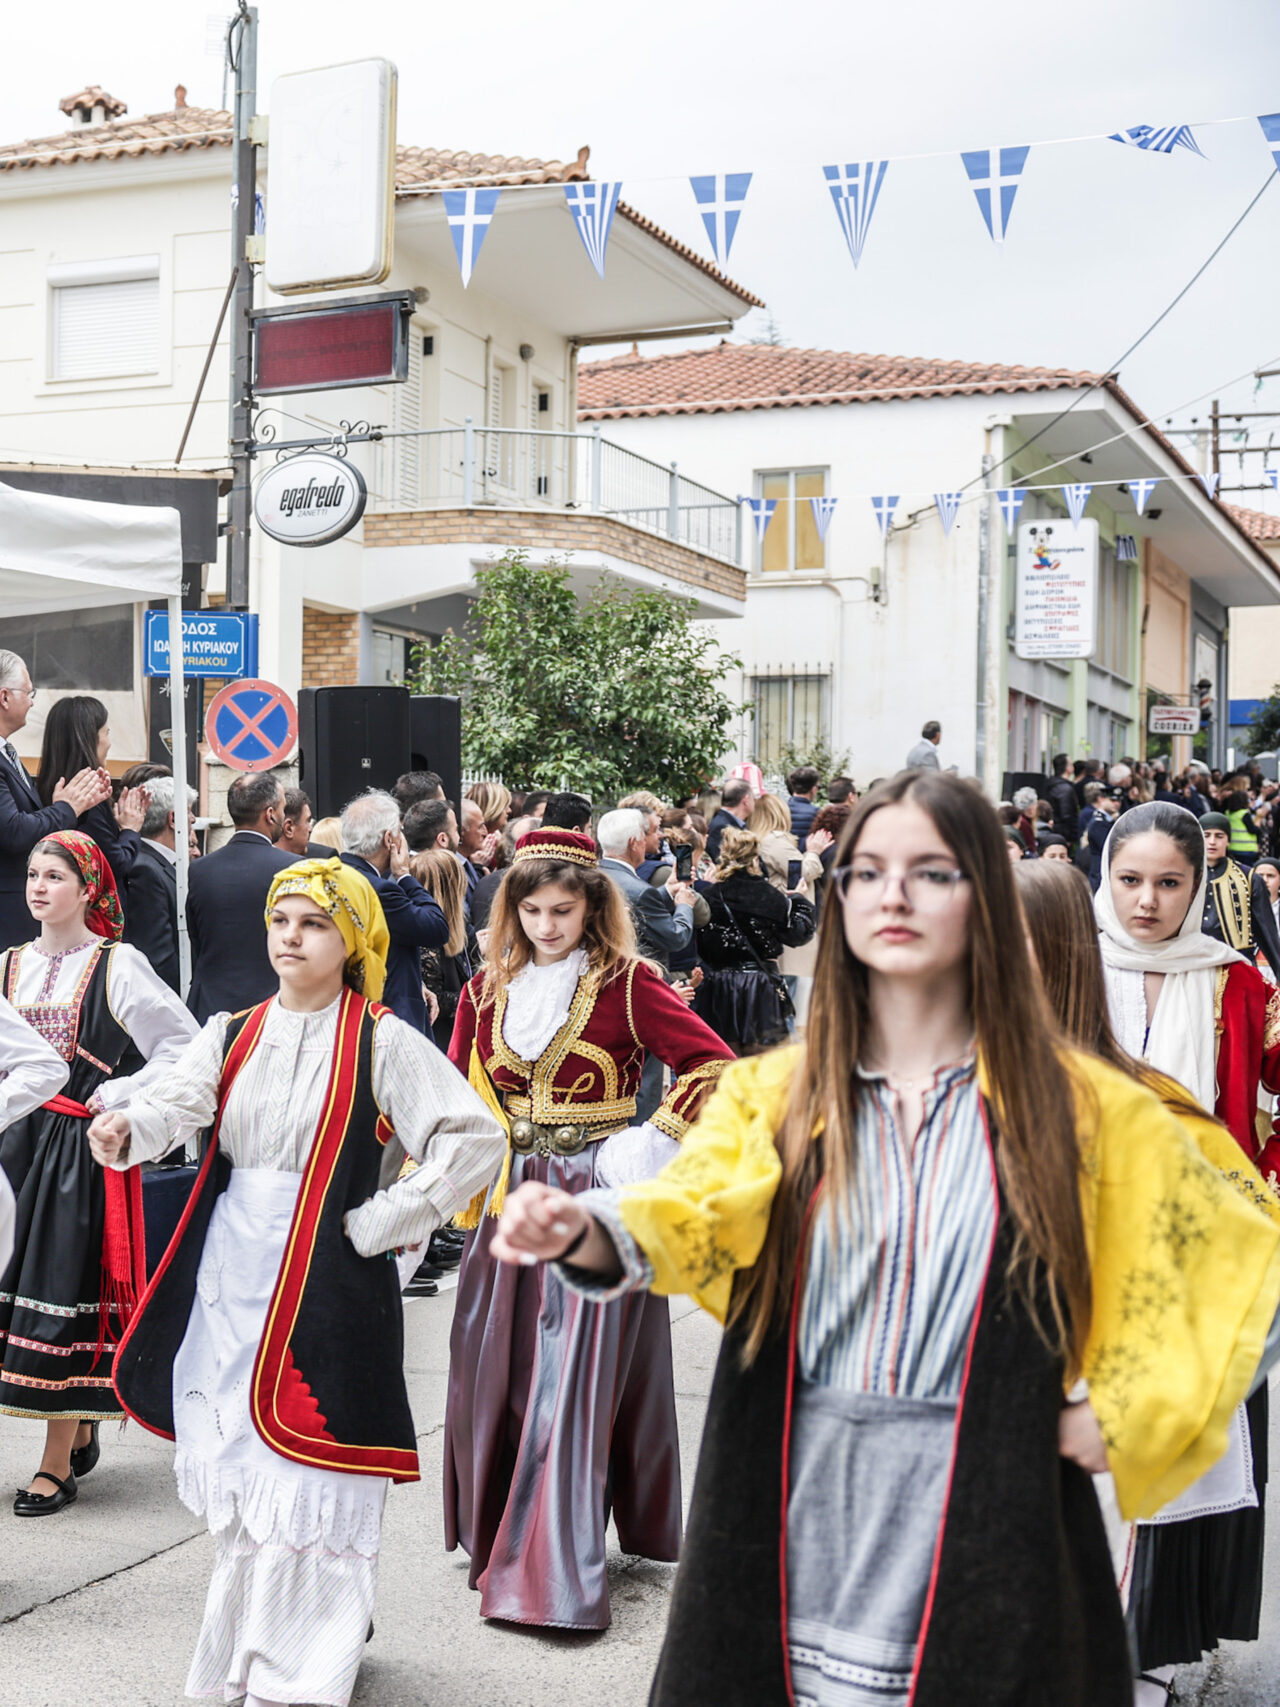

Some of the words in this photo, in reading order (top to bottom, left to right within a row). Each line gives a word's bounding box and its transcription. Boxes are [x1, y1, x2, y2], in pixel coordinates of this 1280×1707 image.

[297, 509, 328, 518] ZANETTI
[154, 640, 191, 653] ΙΩΑΗ
[192, 641, 239, 655] ΚΥΡΙΑΚΟΥ
[182, 656, 228, 667] YRIAKOU
